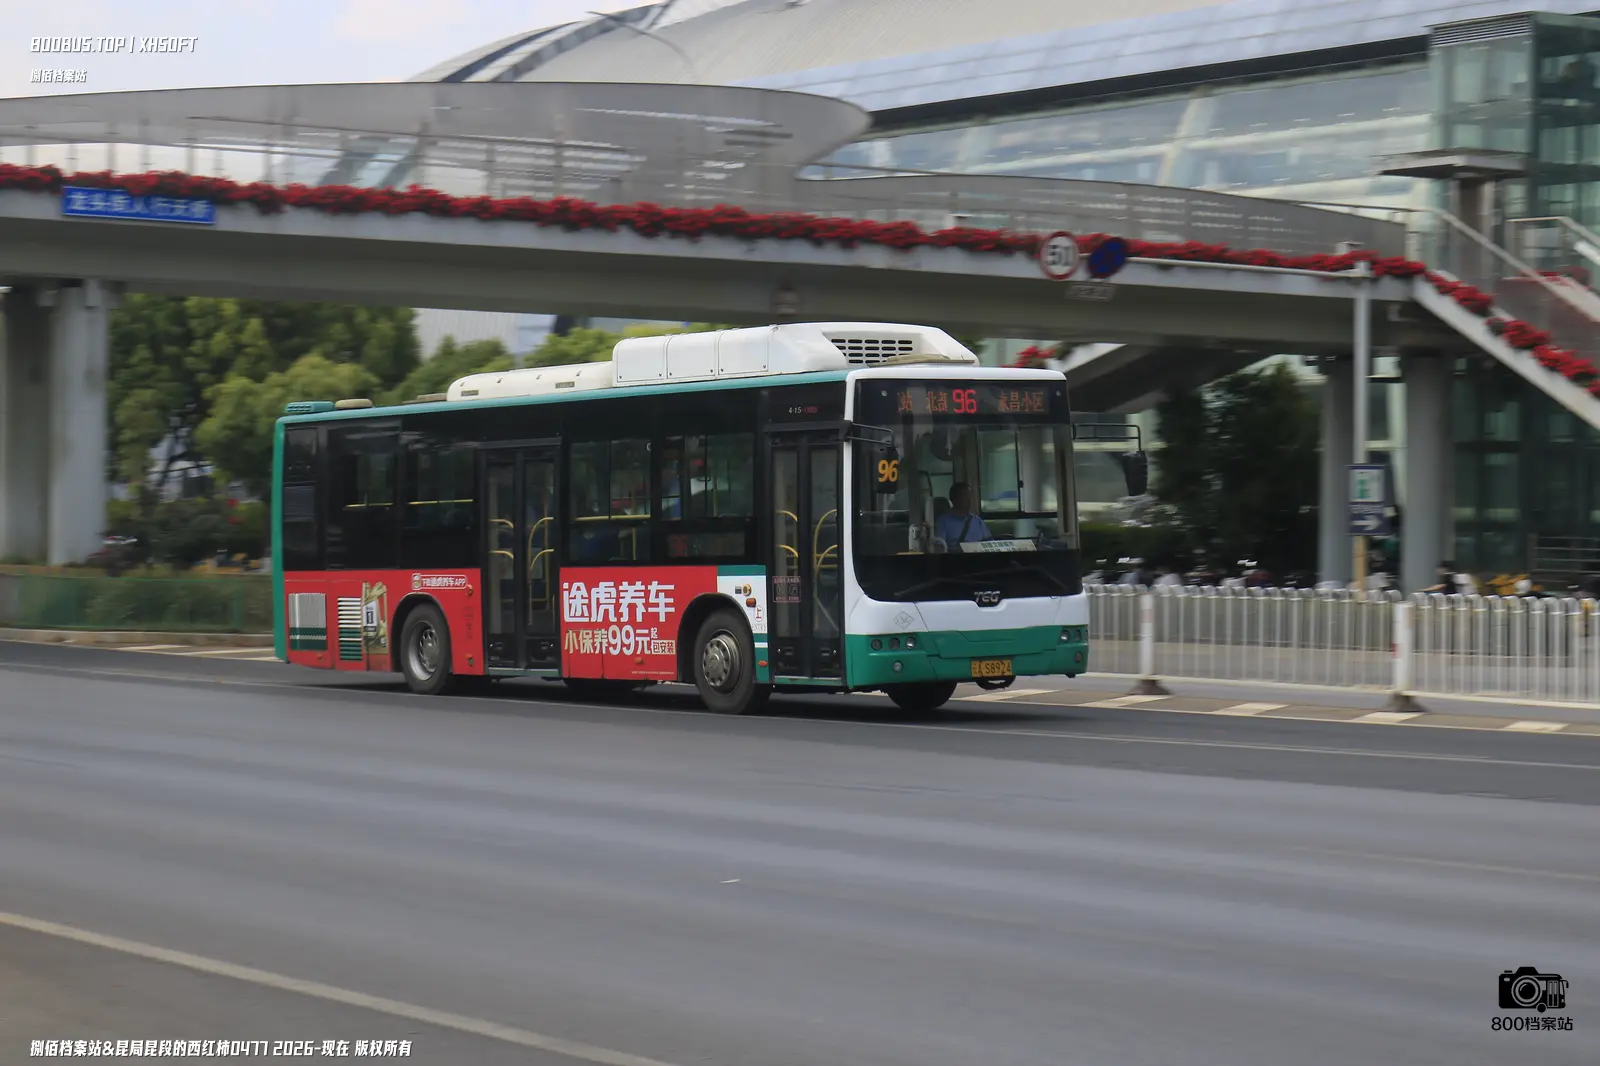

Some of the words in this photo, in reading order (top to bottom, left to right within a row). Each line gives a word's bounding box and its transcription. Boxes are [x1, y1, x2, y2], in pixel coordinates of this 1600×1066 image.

[952, 388, 977, 413] 96
[997, 391, 1044, 412] 永昌小区
[877, 459, 899, 483] 96
[562, 580, 676, 623] 途虎养车
[652, 641, 675, 654] 包安装
